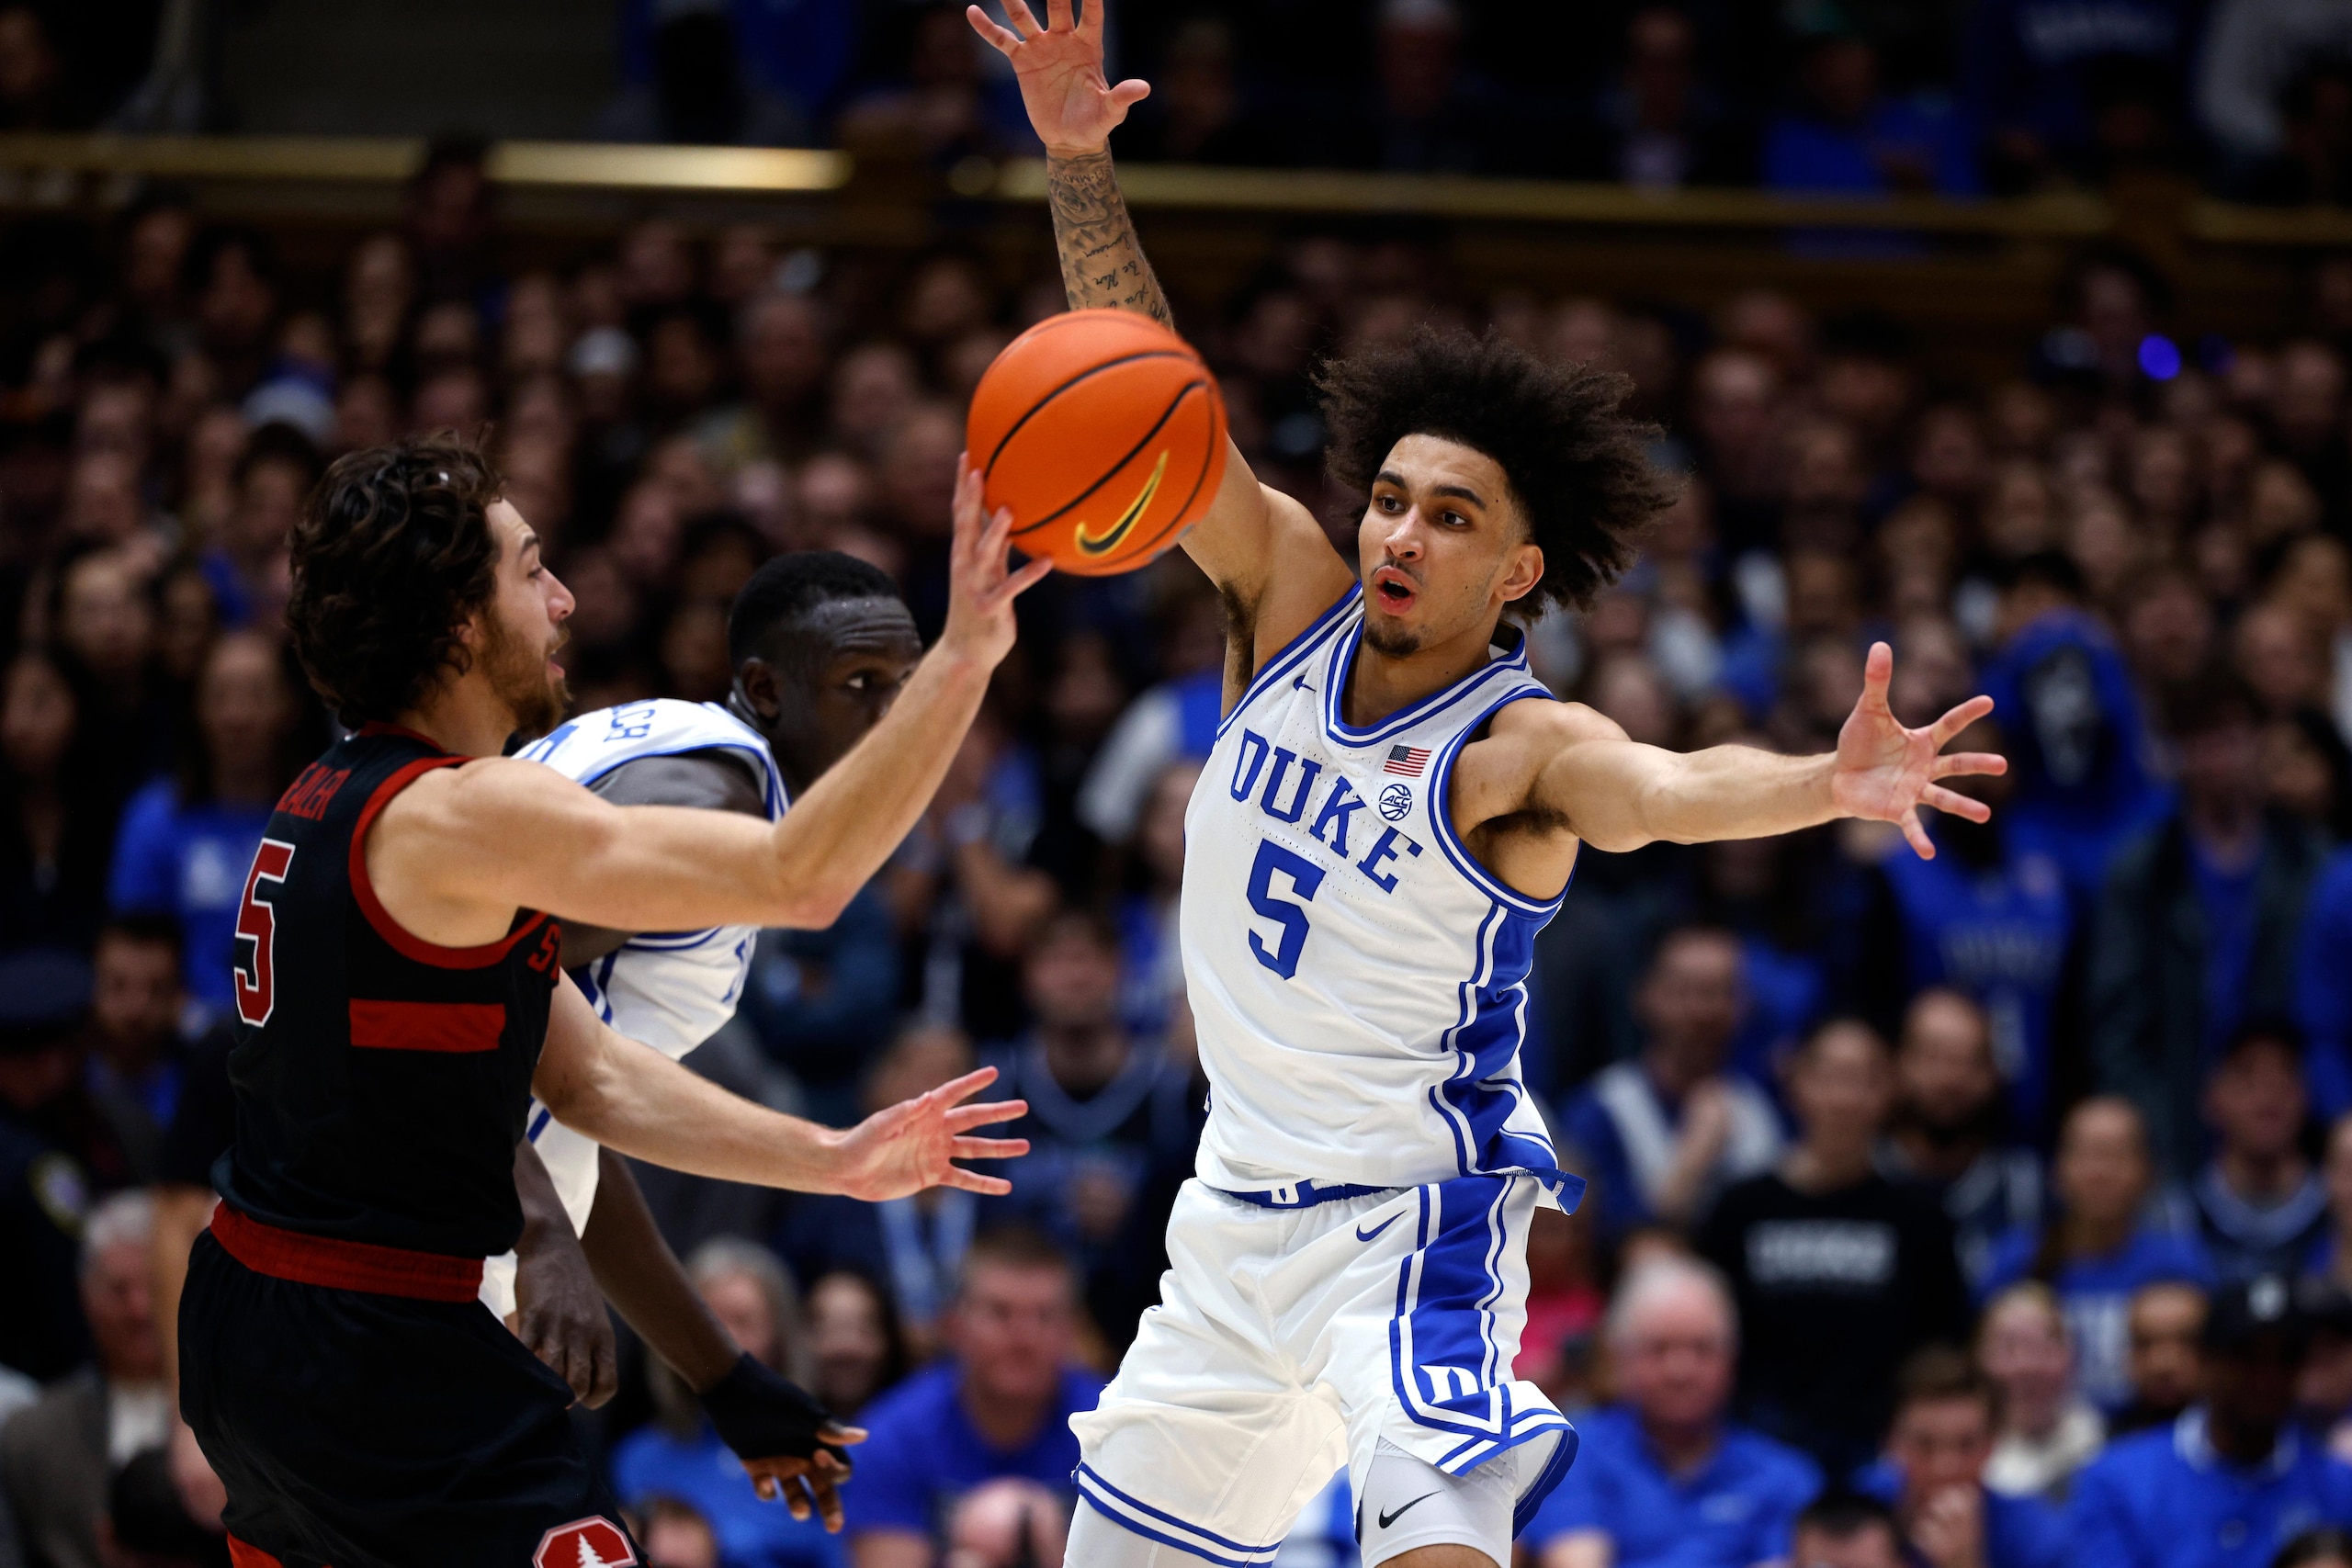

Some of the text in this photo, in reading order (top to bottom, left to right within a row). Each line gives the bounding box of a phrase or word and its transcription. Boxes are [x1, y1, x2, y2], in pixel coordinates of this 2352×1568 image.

[1231, 728, 1423, 895] DUKE
[1383, 795, 1412, 808] ACC
[234, 837, 296, 1028] 5
[1246, 838, 1327, 980] 5
